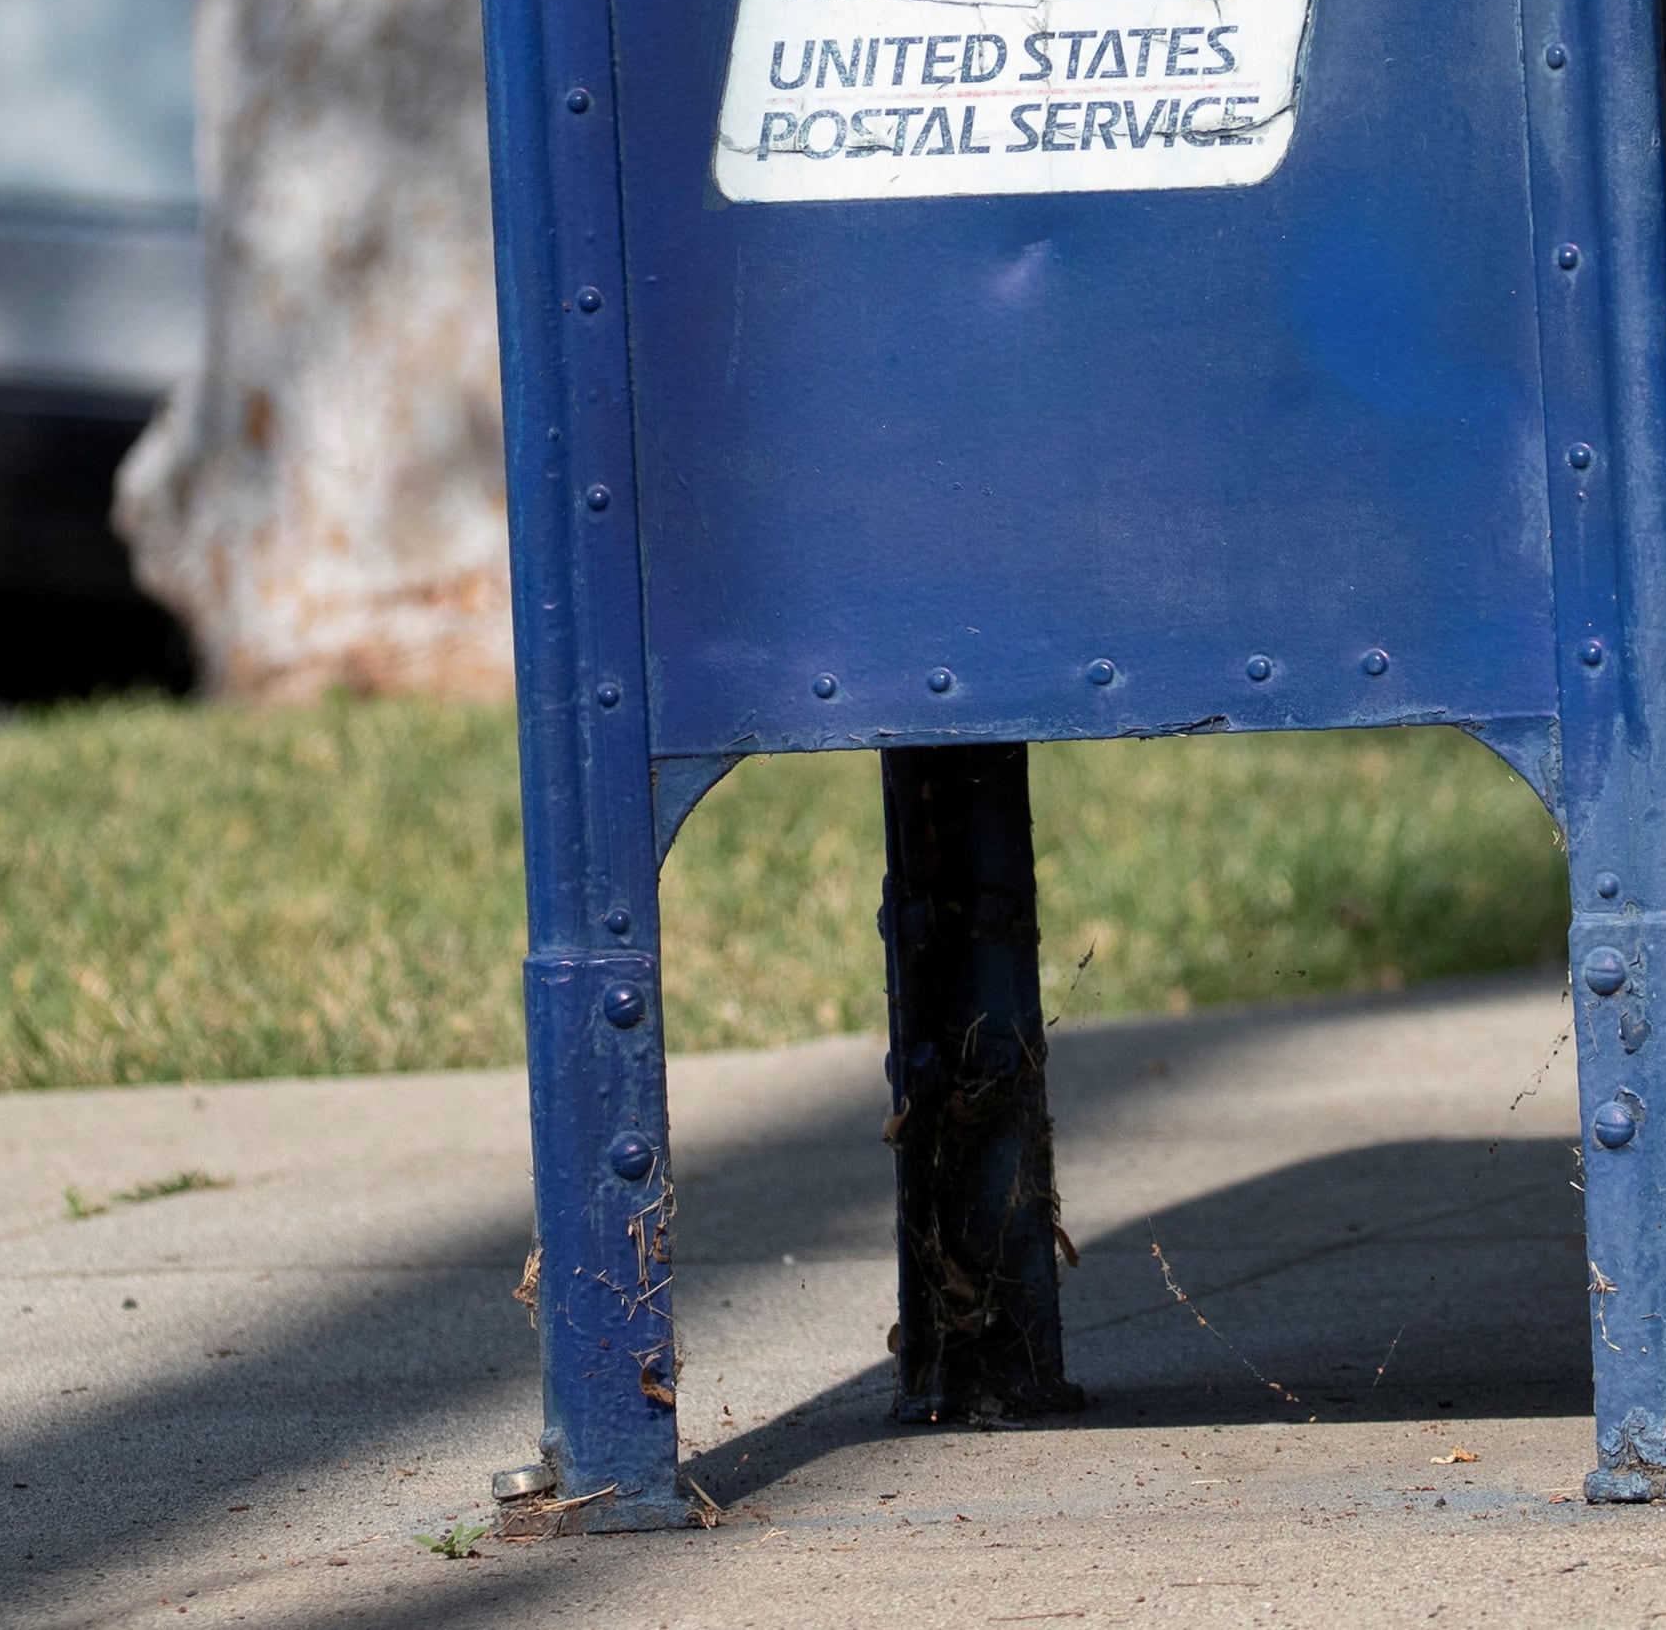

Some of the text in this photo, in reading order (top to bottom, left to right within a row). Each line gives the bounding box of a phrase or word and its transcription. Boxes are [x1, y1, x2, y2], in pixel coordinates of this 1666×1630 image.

[769, 25, 1239, 90] UNITED STATES
[756, 105, 991, 162] POSTAL
